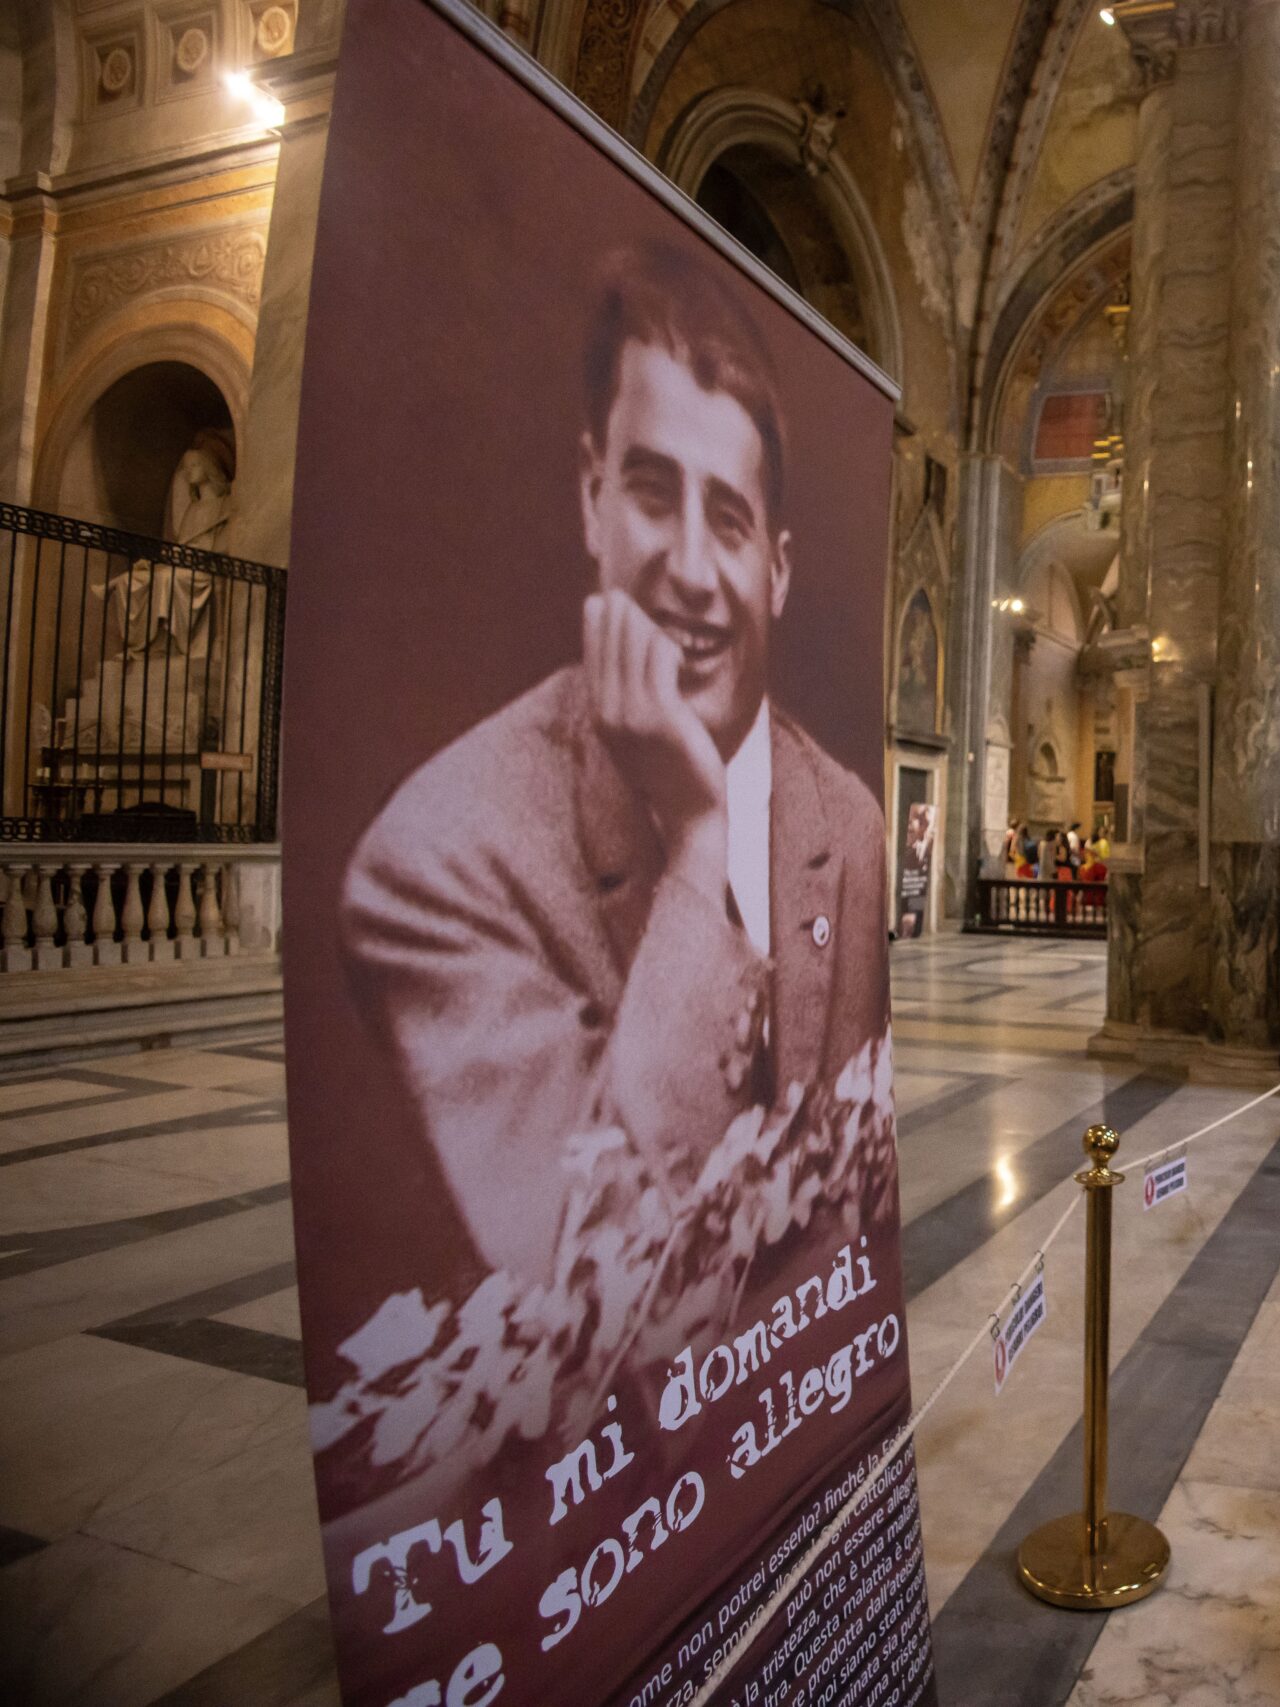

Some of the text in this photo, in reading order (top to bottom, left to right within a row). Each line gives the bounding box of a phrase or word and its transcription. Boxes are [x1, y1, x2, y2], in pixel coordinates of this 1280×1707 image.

[353, 1497, 514, 1635] Tu
[545, 1394, 635, 1526] mi
[658, 1235, 877, 1431] domandi
[538, 1471, 706, 1652] sono
[726, 1313, 900, 1479] allegro
[629, 1662, 673, 1707] ome
[678, 1621, 713, 1669] non
[718, 1561, 766, 1633] potrei
[769, 1502, 821, 1574] esserlo?
[824, 1461, 865, 1514] finché
[868, 1454, 880, 1473] la
[745, 1681, 759, 1707] la
[762, 1609, 821, 1685] tristezza,
[823, 1575, 847, 1610] che
[849, 1560, 858, 1581] è
[861, 1536, 885, 1568] una
[764, 1679, 792, 1707] ltra.
[794, 1614, 841, 1676] Questa
[843, 1556, 893, 1621] malattia
[895, 1541, 902, 1561] è
[786, 1579, 813, 1627] può
[815, 1550, 842, 1588] non
[844, 1508, 884, 1556] essere
[840, 1632, 877, 1684] siamo
[879, 1593, 904, 1637] stati
[807, 1617, 864, 1699] prodotta
[838, 1599, 922, 1707] minata sia pure
[867, 1673, 889, 1707] una
[890, 1634, 918, 1677] triste
